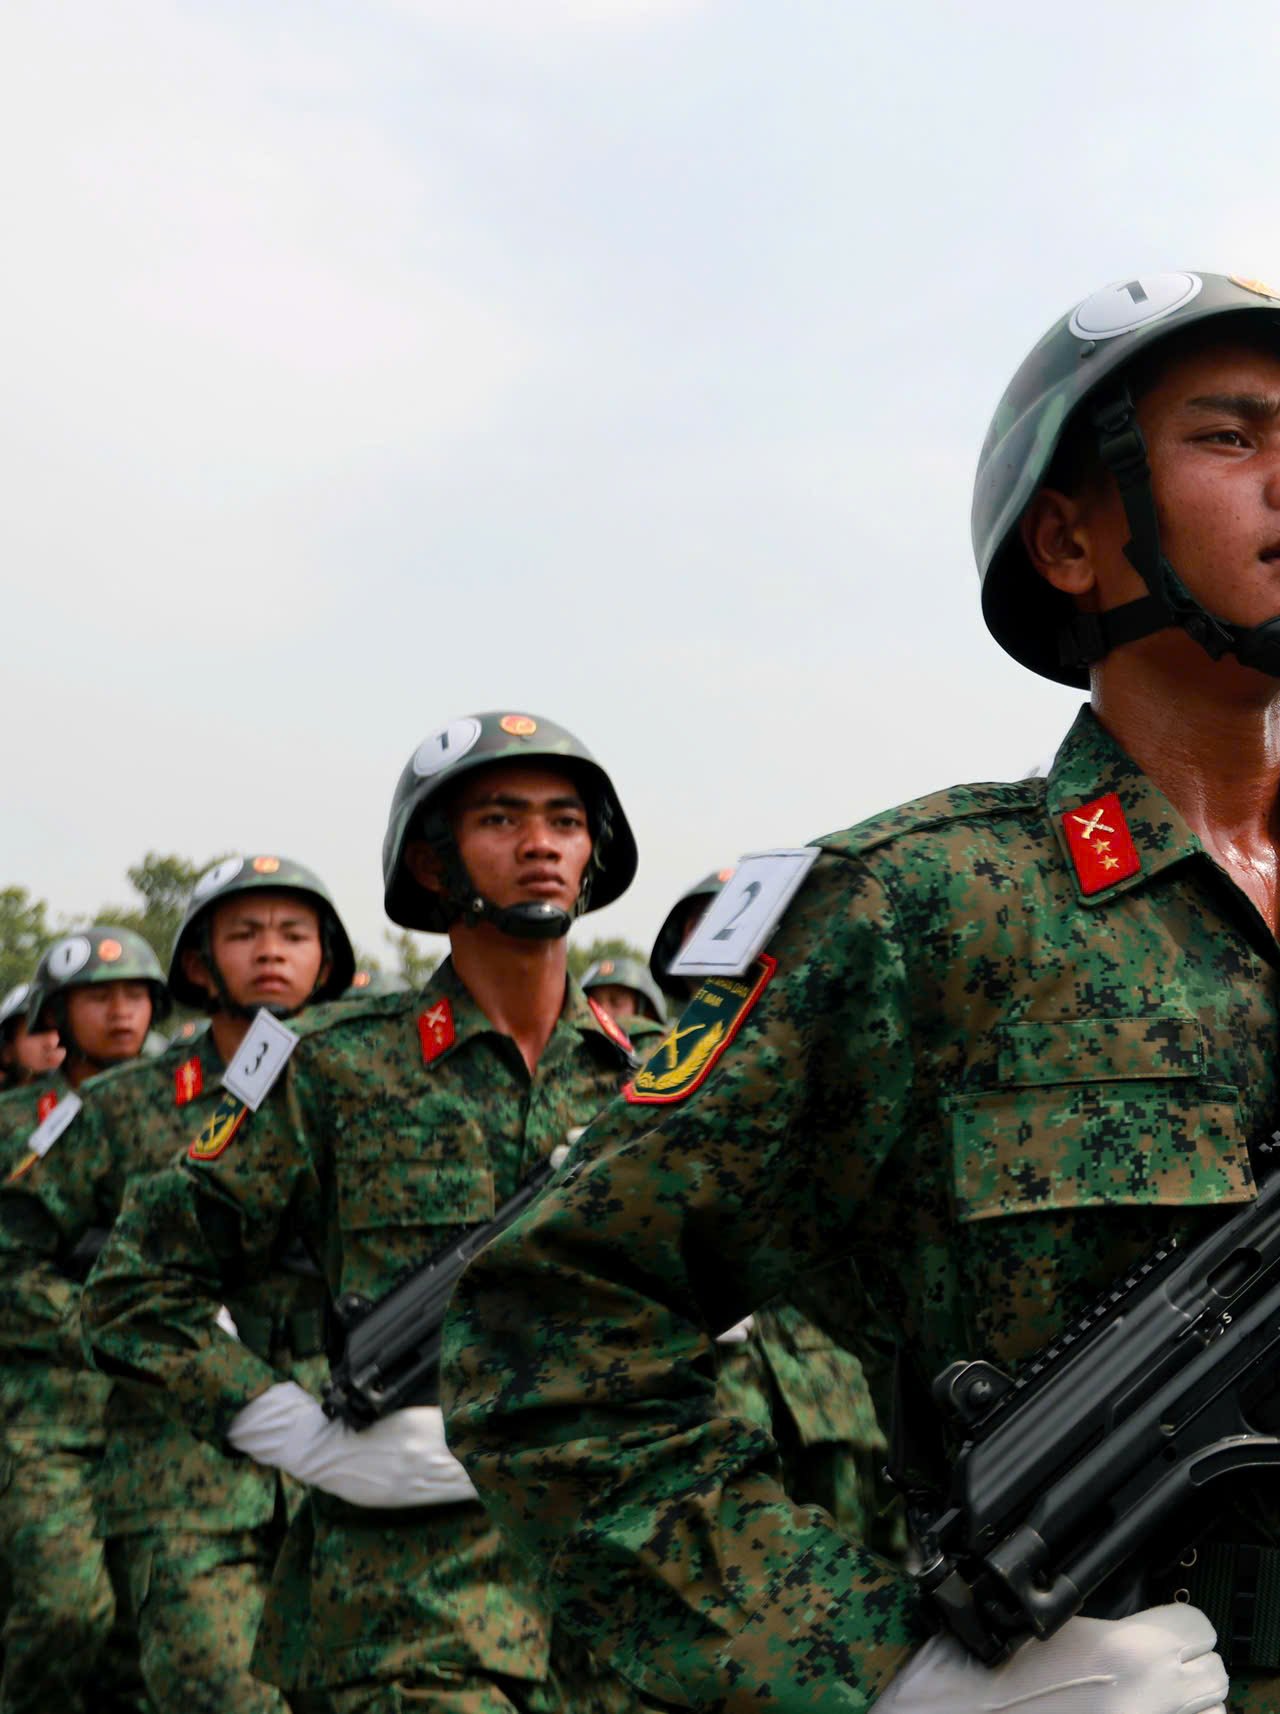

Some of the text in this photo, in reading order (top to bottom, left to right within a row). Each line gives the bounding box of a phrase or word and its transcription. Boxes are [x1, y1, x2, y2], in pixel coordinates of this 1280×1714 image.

[1116, 280, 1149, 304] 1
[436, 730, 449, 750] 1
[711, 880, 762, 941] 2
[243, 1040, 269, 1077] 3
[1221, 1311, 1233, 1325] S
